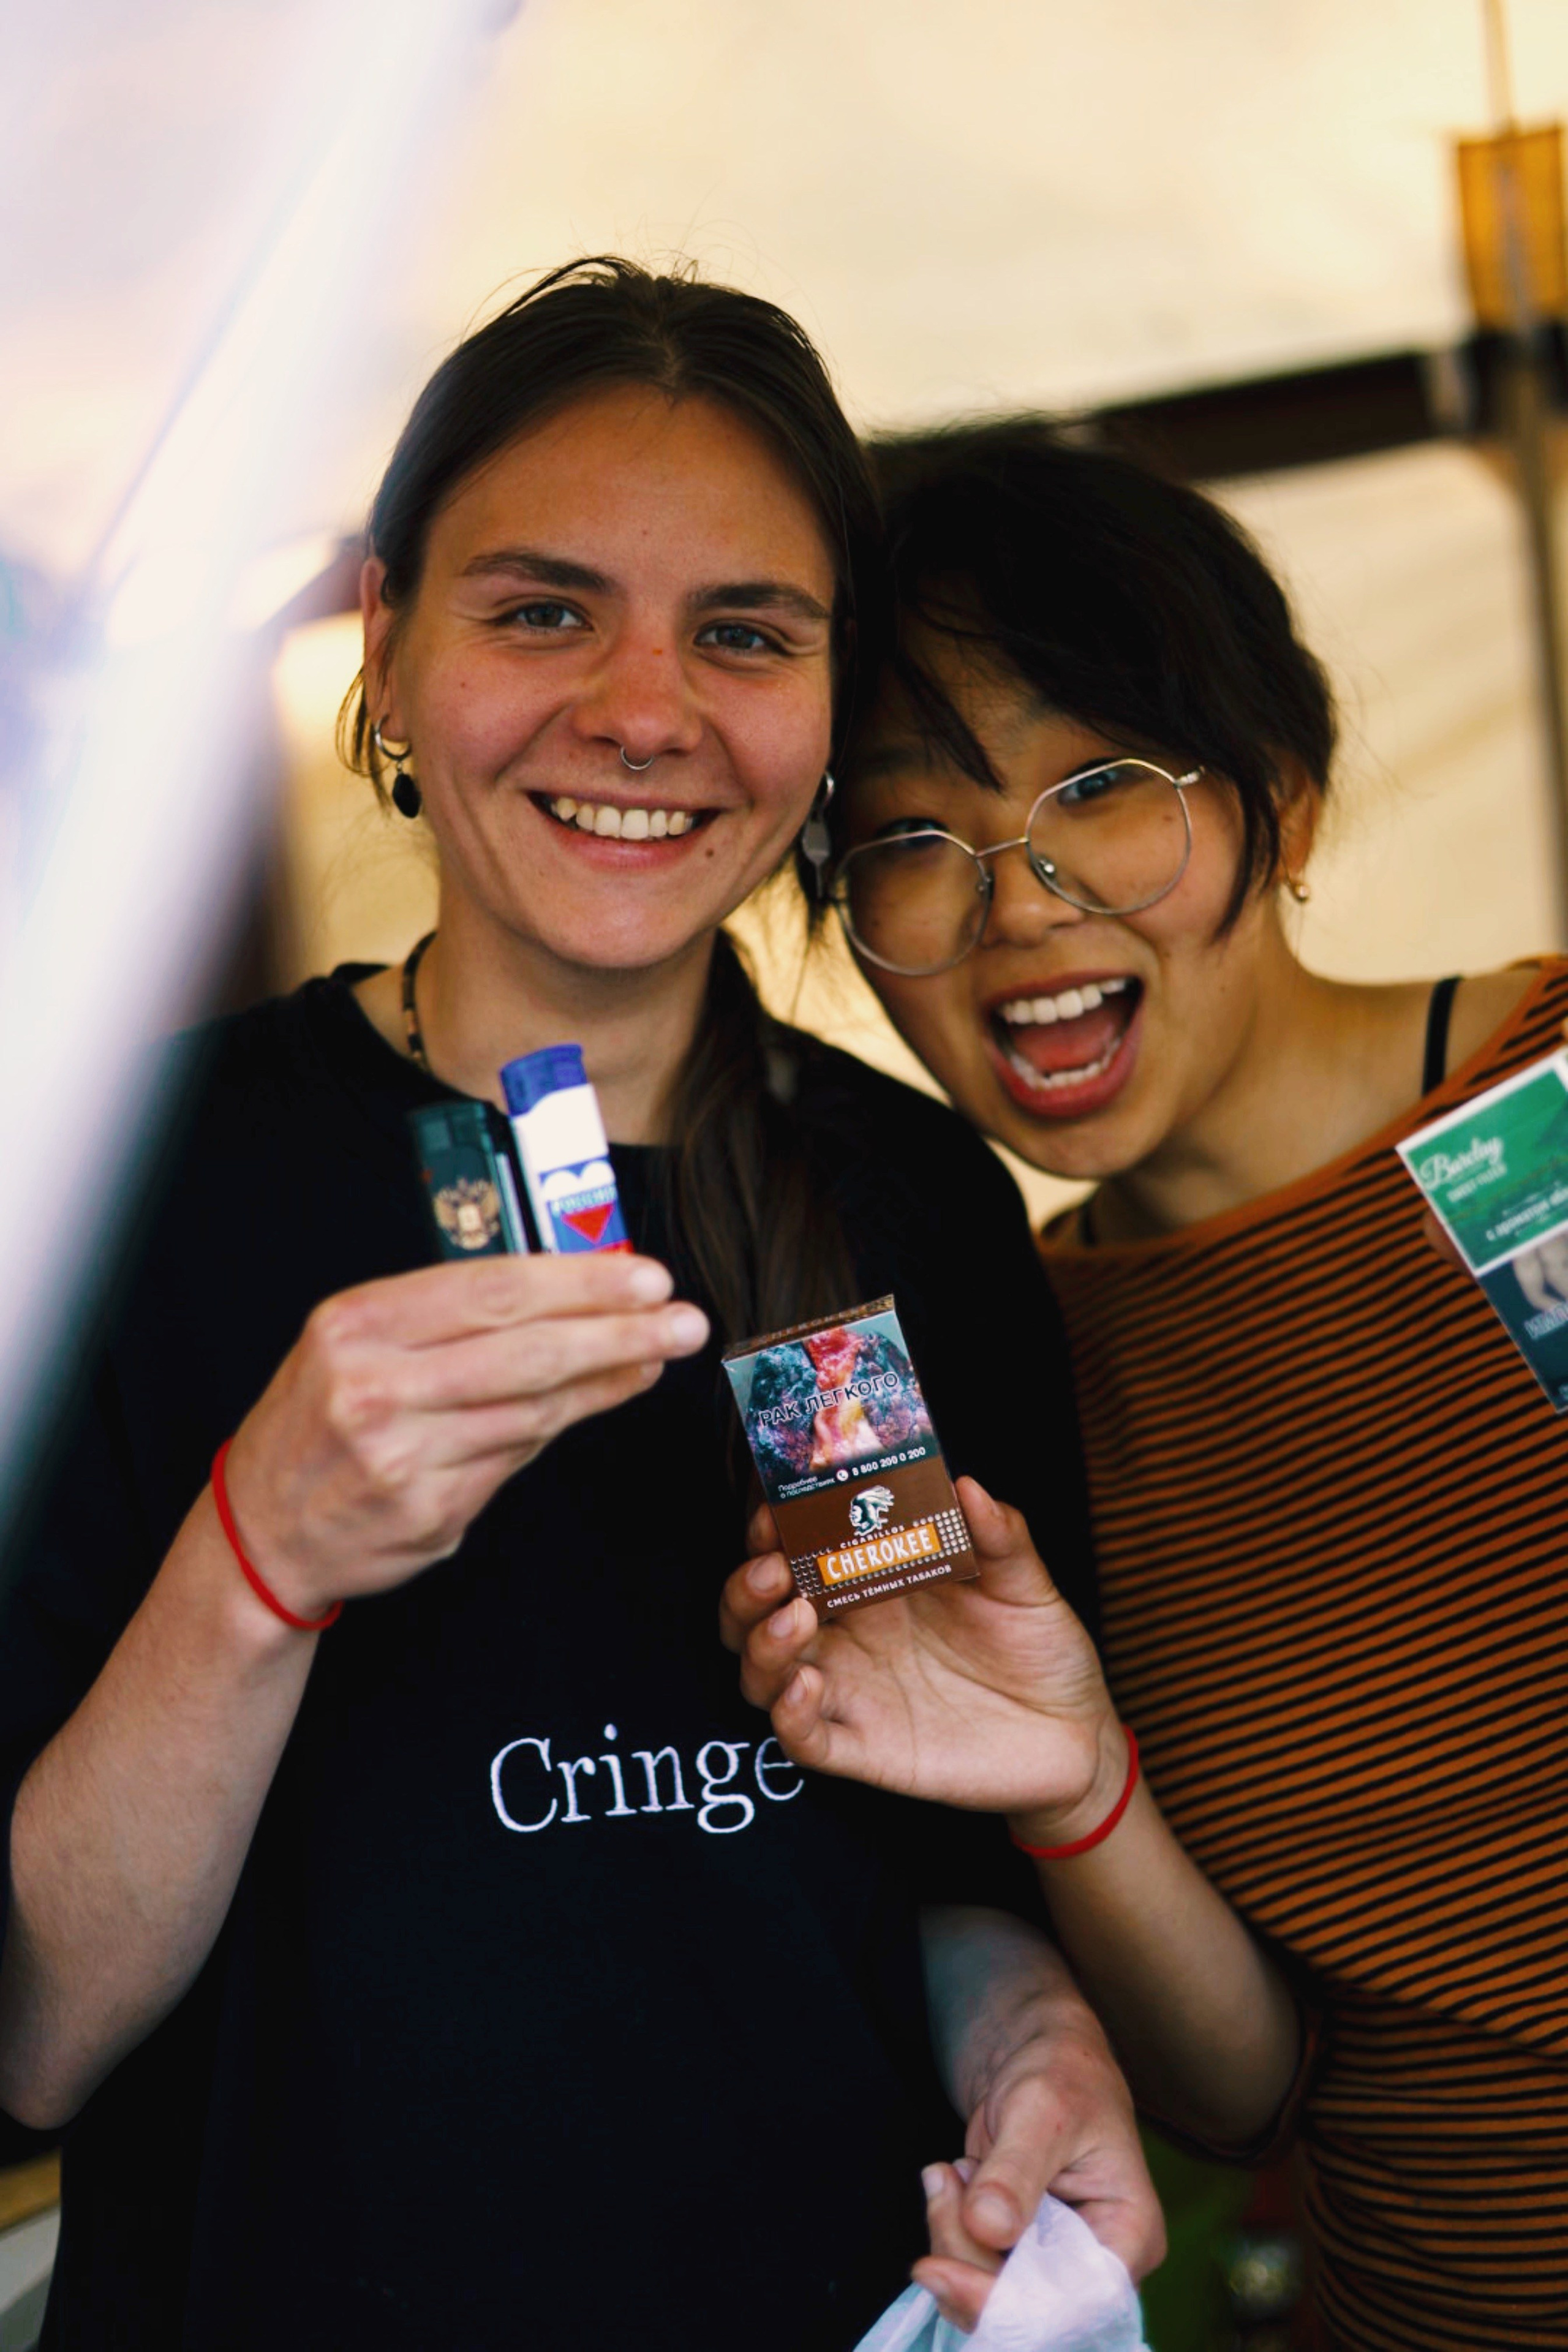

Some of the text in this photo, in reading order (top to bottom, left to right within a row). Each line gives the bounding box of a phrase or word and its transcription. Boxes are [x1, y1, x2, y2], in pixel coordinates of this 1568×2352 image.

[760, 1371, 899, 1427] РАК ЛЕГКОГО
[852, 1446, 926, 1477] 8 800 200 0 200
[826, 1528, 933, 1580] CHEROKEE
[840, 1525, 905, 1550] CIGARILLOS
[827, 1593, 861, 1608] СМЕСЬ
[905, 1564, 952, 1584] ТАБАКОВ
[491, 1724, 804, 1834] Cringe
